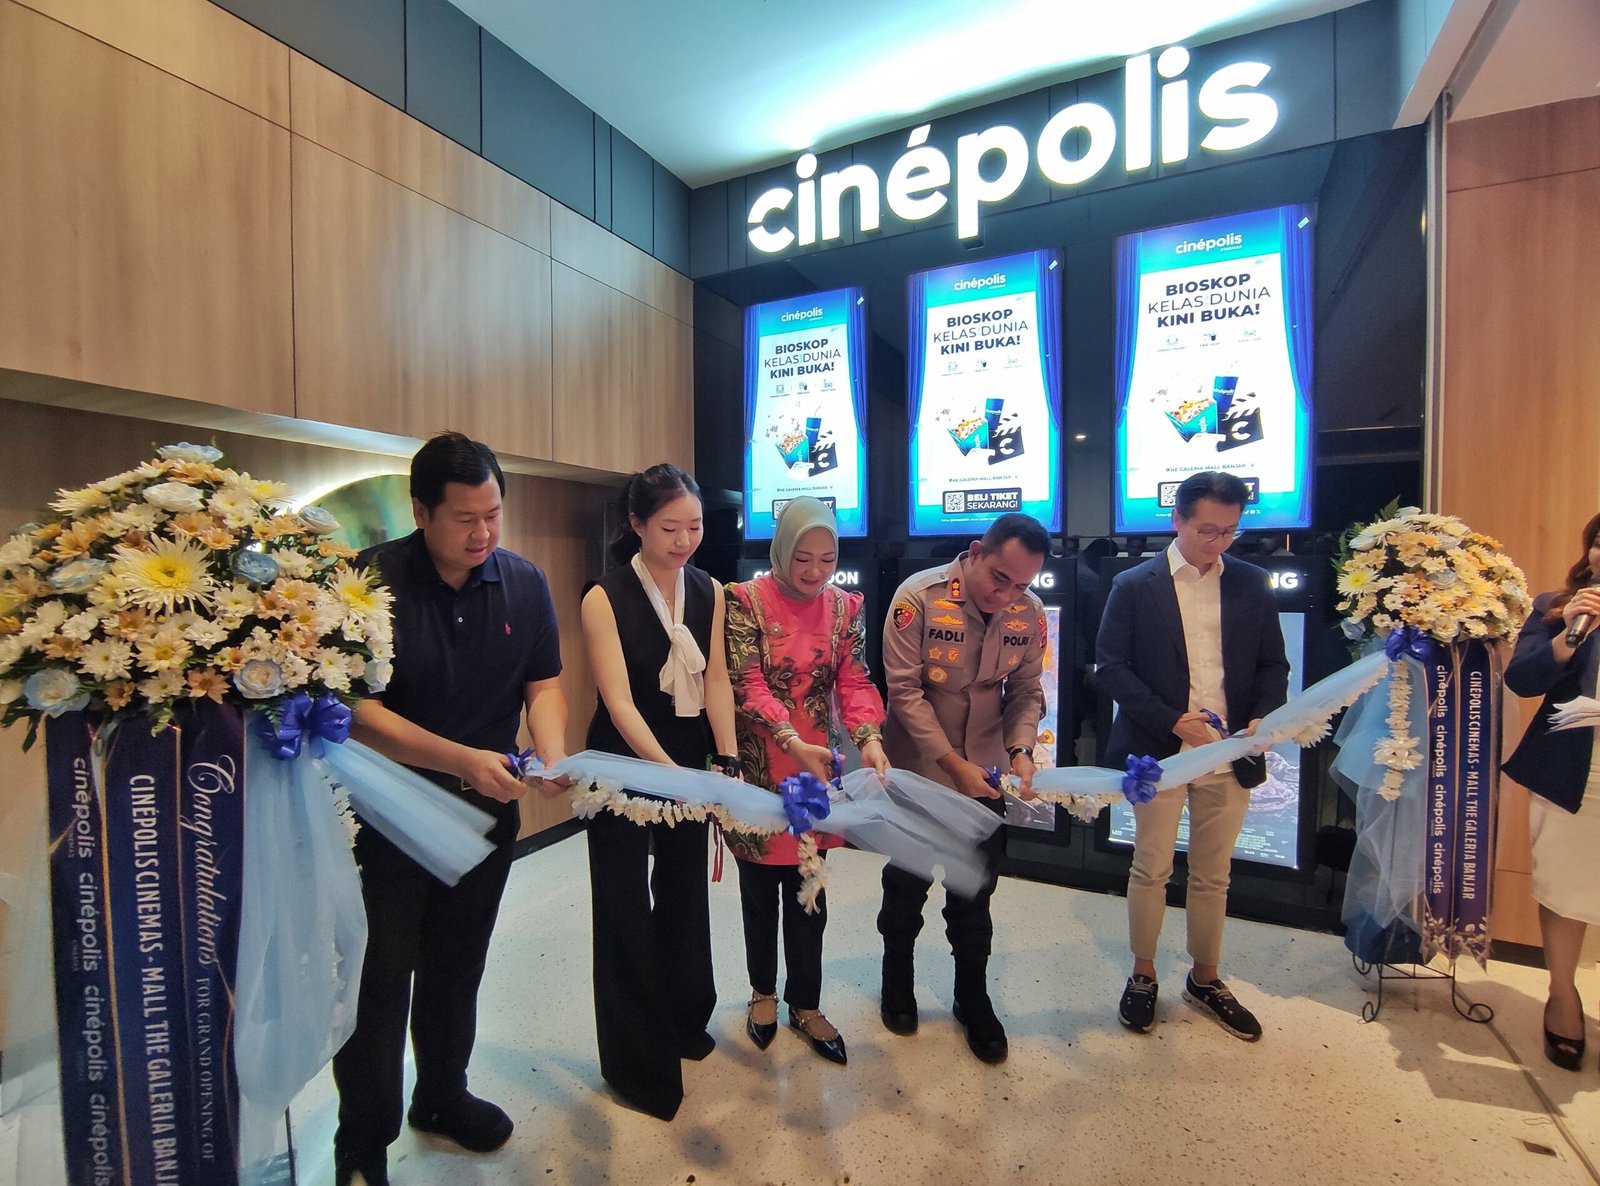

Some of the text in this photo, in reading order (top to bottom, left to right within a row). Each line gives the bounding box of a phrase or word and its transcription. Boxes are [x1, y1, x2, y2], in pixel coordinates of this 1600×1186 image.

[747, 45, 1279, 253] cinépolis
[1175, 232, 1243, 255] cinépolis
[953, 272, 1006, 291] cinépolis
[1165, 273, 1251, 297] BIOSKOP
[1148, 286, 1271, 315] KELAS DUNIA
[781, 307, 823, 323] cinépolis
[947, 308, 1013, 328] BIOSKOP
[1157, 303, 1260, 328] KINI BUKA!
[933, 320, 1029, 343] KELAS DUNIA
[775, 338, 829, 355] BIOSKOP
[941, 335, 1021, 356] KINI BUKA!
[764, 349, 841, 369] KELAS DUNIA
[770, 362, 835, 379] KINI BUKA!
[966, 500, 1018, 510] SEKARANG!
[967, 491, 1019, 502] BELI TIKET
[928, 627, 965, 644] FADLI
[1436, 665, 1449, 719] cinépolis
[1434, 724, 1448, 778] cinépolis
[1462, 670, 1483, 900] CINÉPOLIS CINEMAS MALL THE GALERIA BANJAR
[72, 756, 95, 858] cinépolis
[1433, 784, 1447, 837] cinépolis
[1431, 842, 1446, 895] cinépolis
[77, 872, 103, 971] cinépolis
[180, 754, 237, 1162] Congratulations FOR GRAND OPENING OF
[129, 774, 181, 1186] CINÉPOLIS CINEMAS MALL THE GALERIA BANJ
[82, 984, 109, 1082] cinépolis
